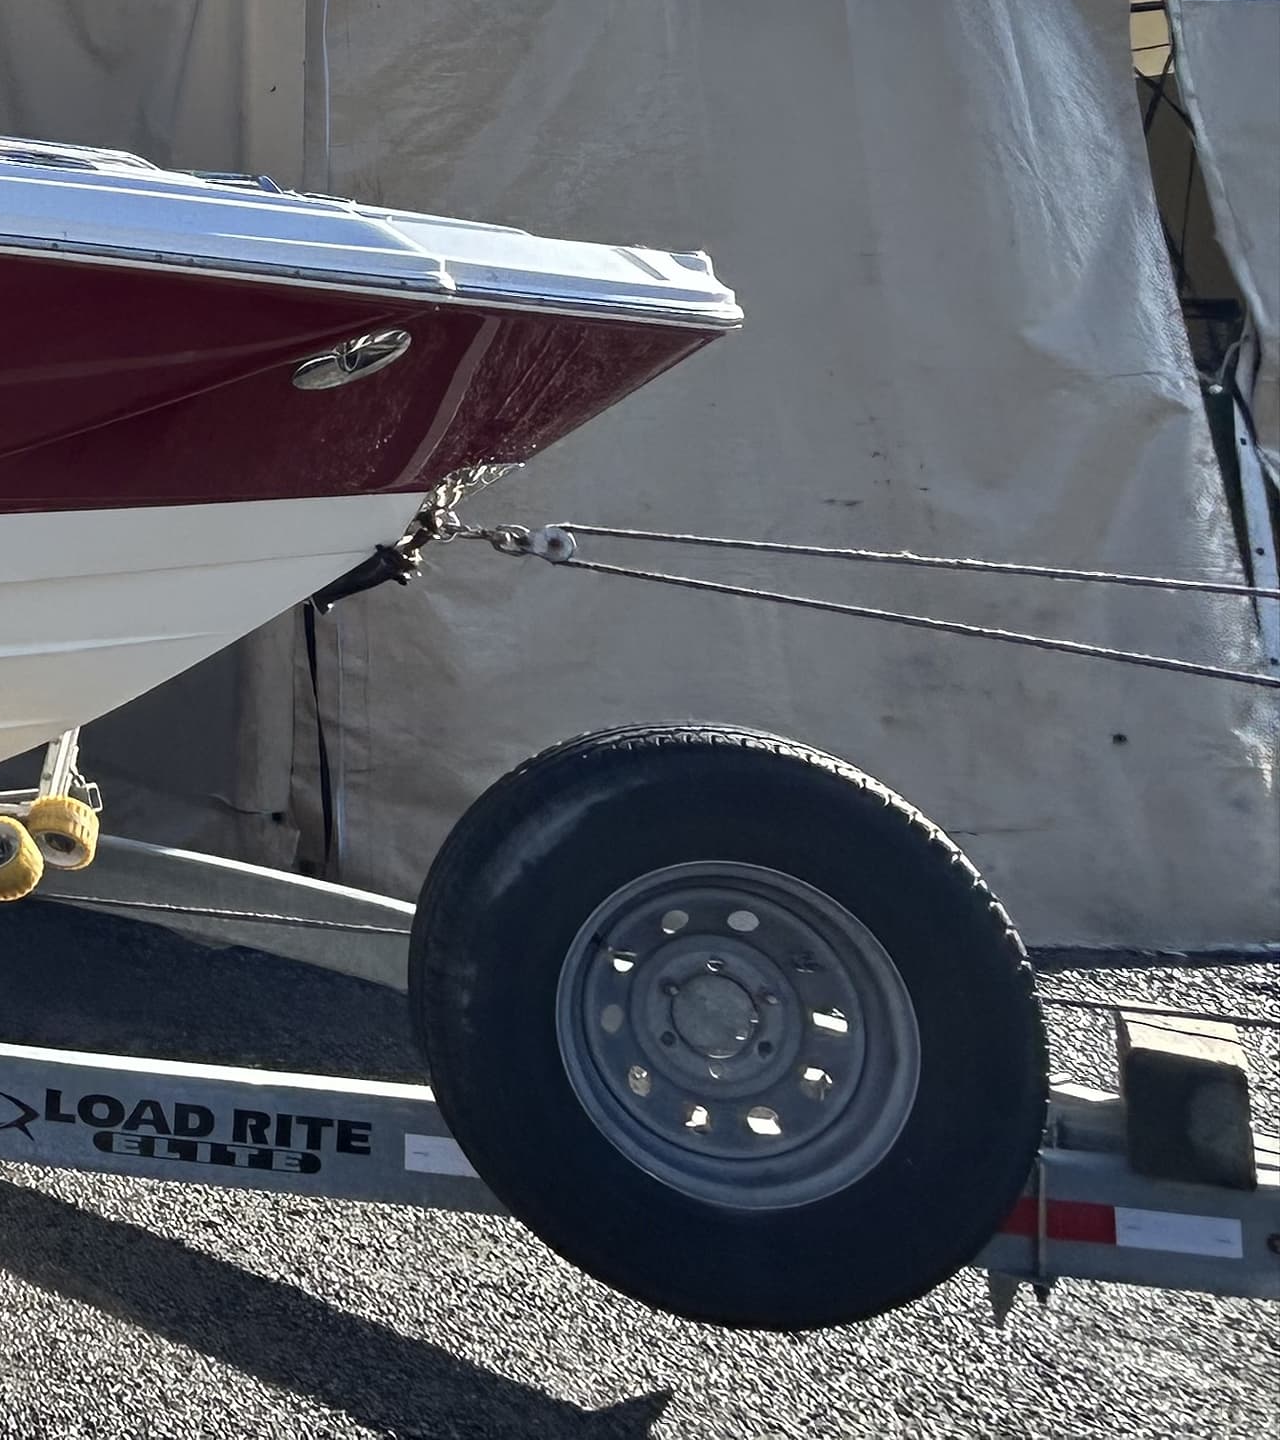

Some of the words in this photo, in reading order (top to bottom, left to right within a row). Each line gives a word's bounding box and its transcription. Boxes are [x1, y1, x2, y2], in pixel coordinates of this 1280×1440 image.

[44, 1088, 215, 1137] LOAD
[232, 1108, 373, 1155] RITE
[110, 1133, 304, 1173] ELITE
